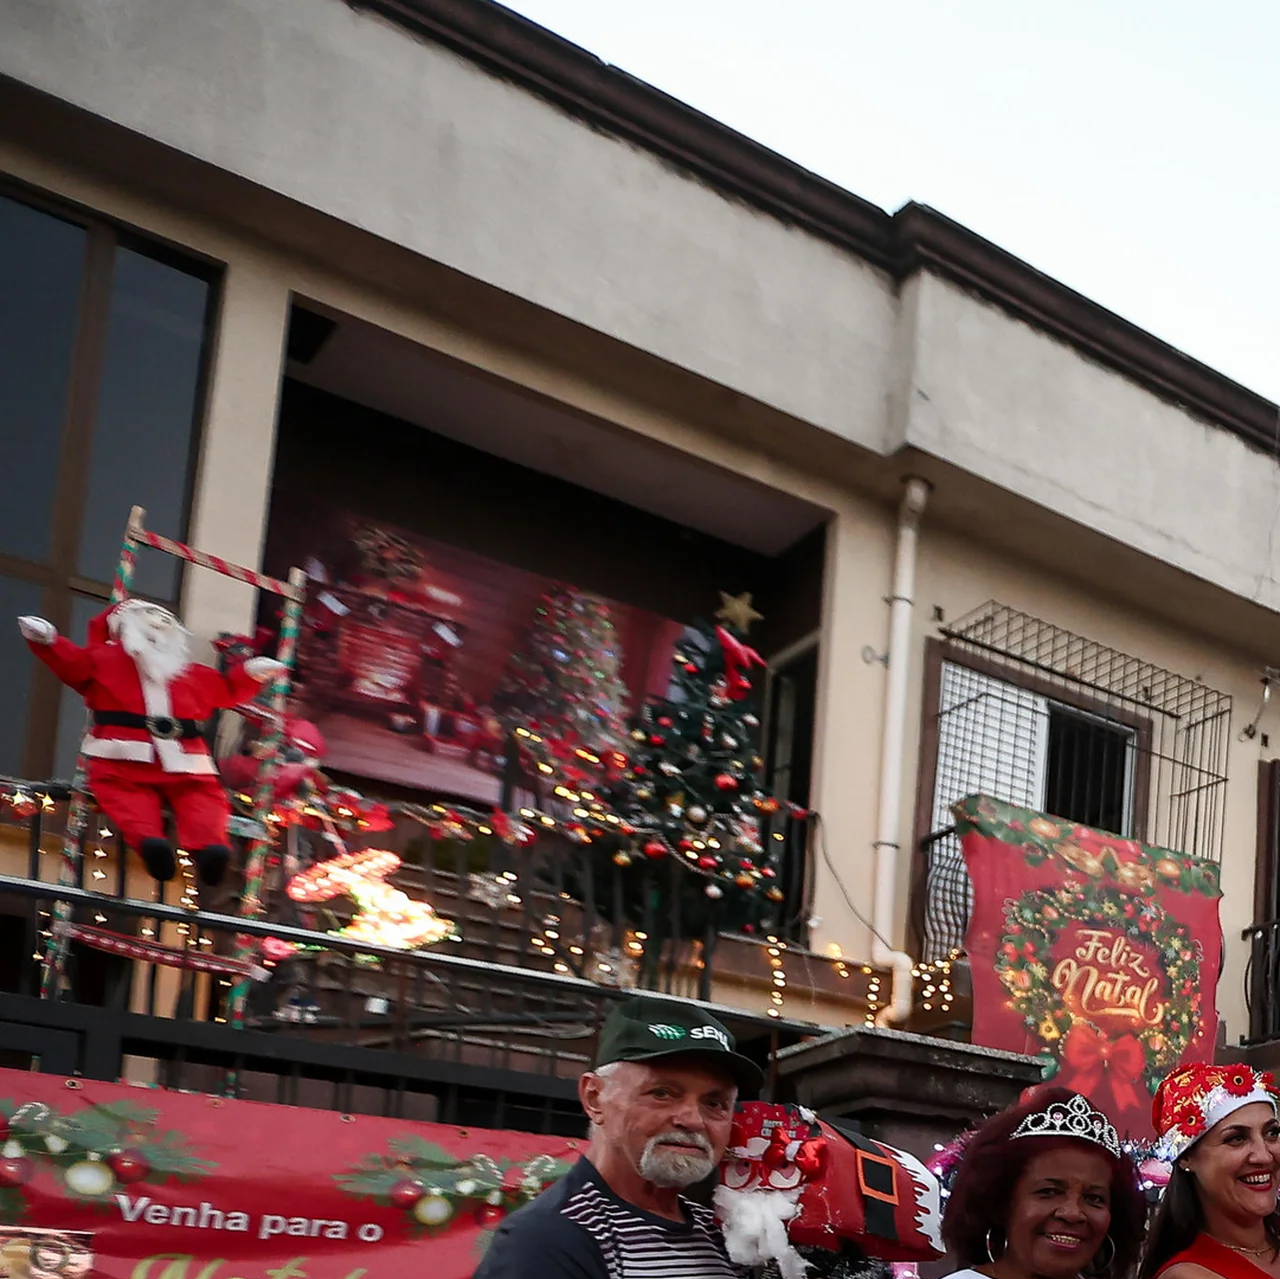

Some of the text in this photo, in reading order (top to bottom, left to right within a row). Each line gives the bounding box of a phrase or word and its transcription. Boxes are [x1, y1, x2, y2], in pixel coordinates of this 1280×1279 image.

[1075, 929, 1150, 977] Feliz
[1052, 958, 1165, 1025] Natal
[115, 1194, 384, 1242] Venha para o
